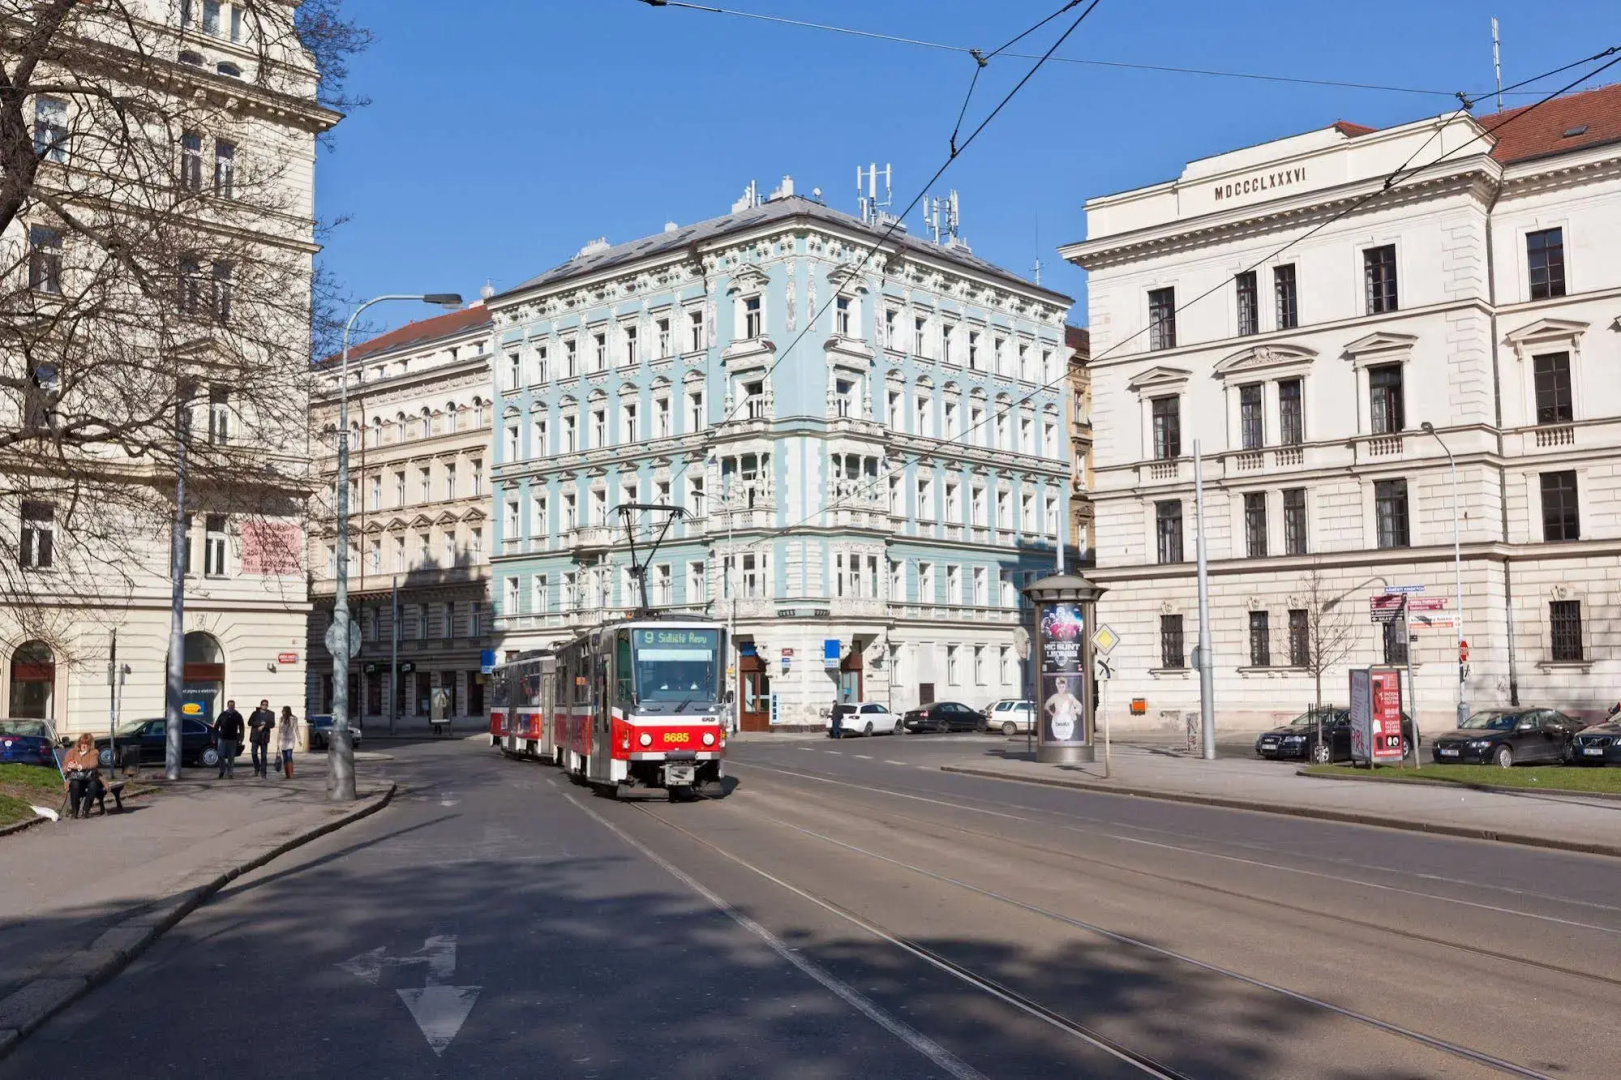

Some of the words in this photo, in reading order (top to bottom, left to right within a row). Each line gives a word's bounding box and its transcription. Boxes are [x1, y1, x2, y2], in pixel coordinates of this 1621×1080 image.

[1215, 167, 1305, 200] MDCCCLXXXVI
[644, 631, 654, 644] 9
[663, 732, 690, 743] 8685
